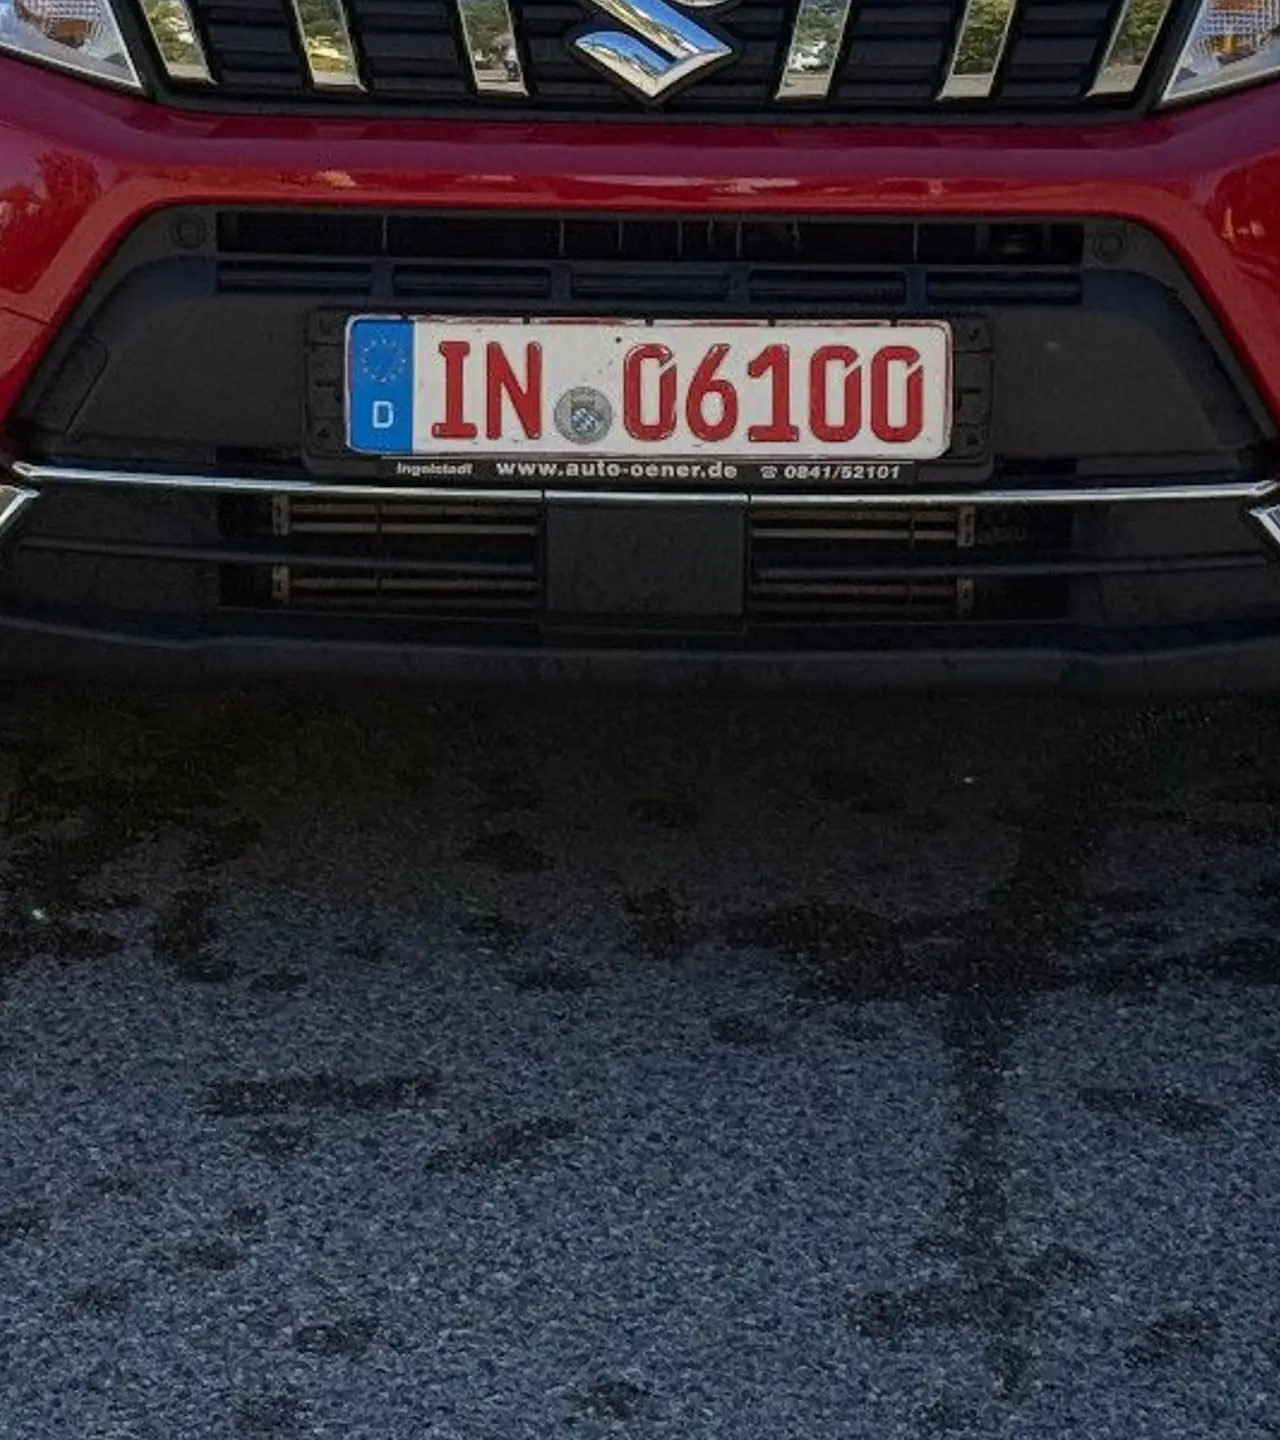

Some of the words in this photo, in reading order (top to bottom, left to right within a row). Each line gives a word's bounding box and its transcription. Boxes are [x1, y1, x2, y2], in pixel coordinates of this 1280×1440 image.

[431, 340, 543, 440] IN
[622, 343, 925, 443] 06100
[372, 401, 395, 429] D
[495, 460, 739, 479] www.auto-oener.de
[783, 464, 900, 481] 0841/52101
